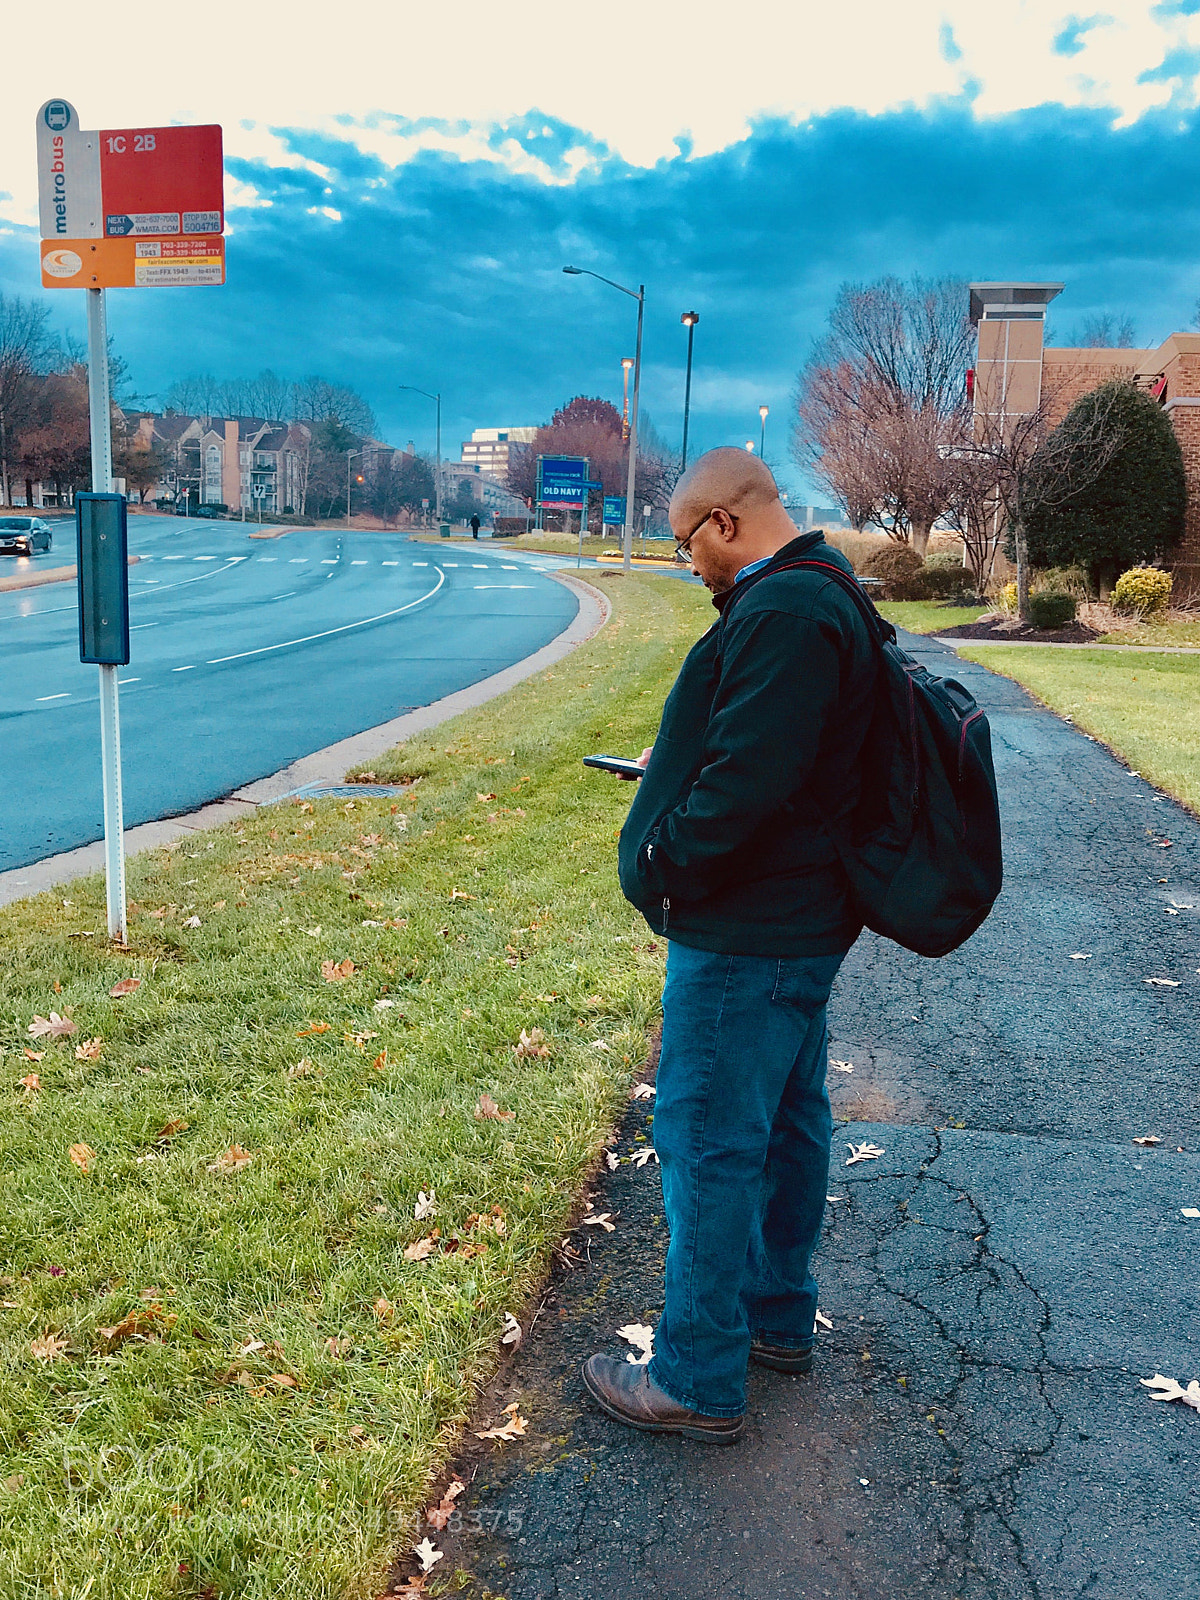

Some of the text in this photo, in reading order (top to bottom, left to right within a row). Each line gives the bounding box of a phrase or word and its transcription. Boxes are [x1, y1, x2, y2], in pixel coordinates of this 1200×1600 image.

[106, 134, 156, 153] 1C 2B
[51, 136, 67, 233] metrobus
[135, 215, 178, 224] 202-637-7000
[184, 214, 199, 222] STOP
[110, 226, 124, 234] BUS
[136, 224, 178, 233] WMATA.COM
[184, 222, 219, 231] 5004716
[560, 487, 582, 496] NAVY
